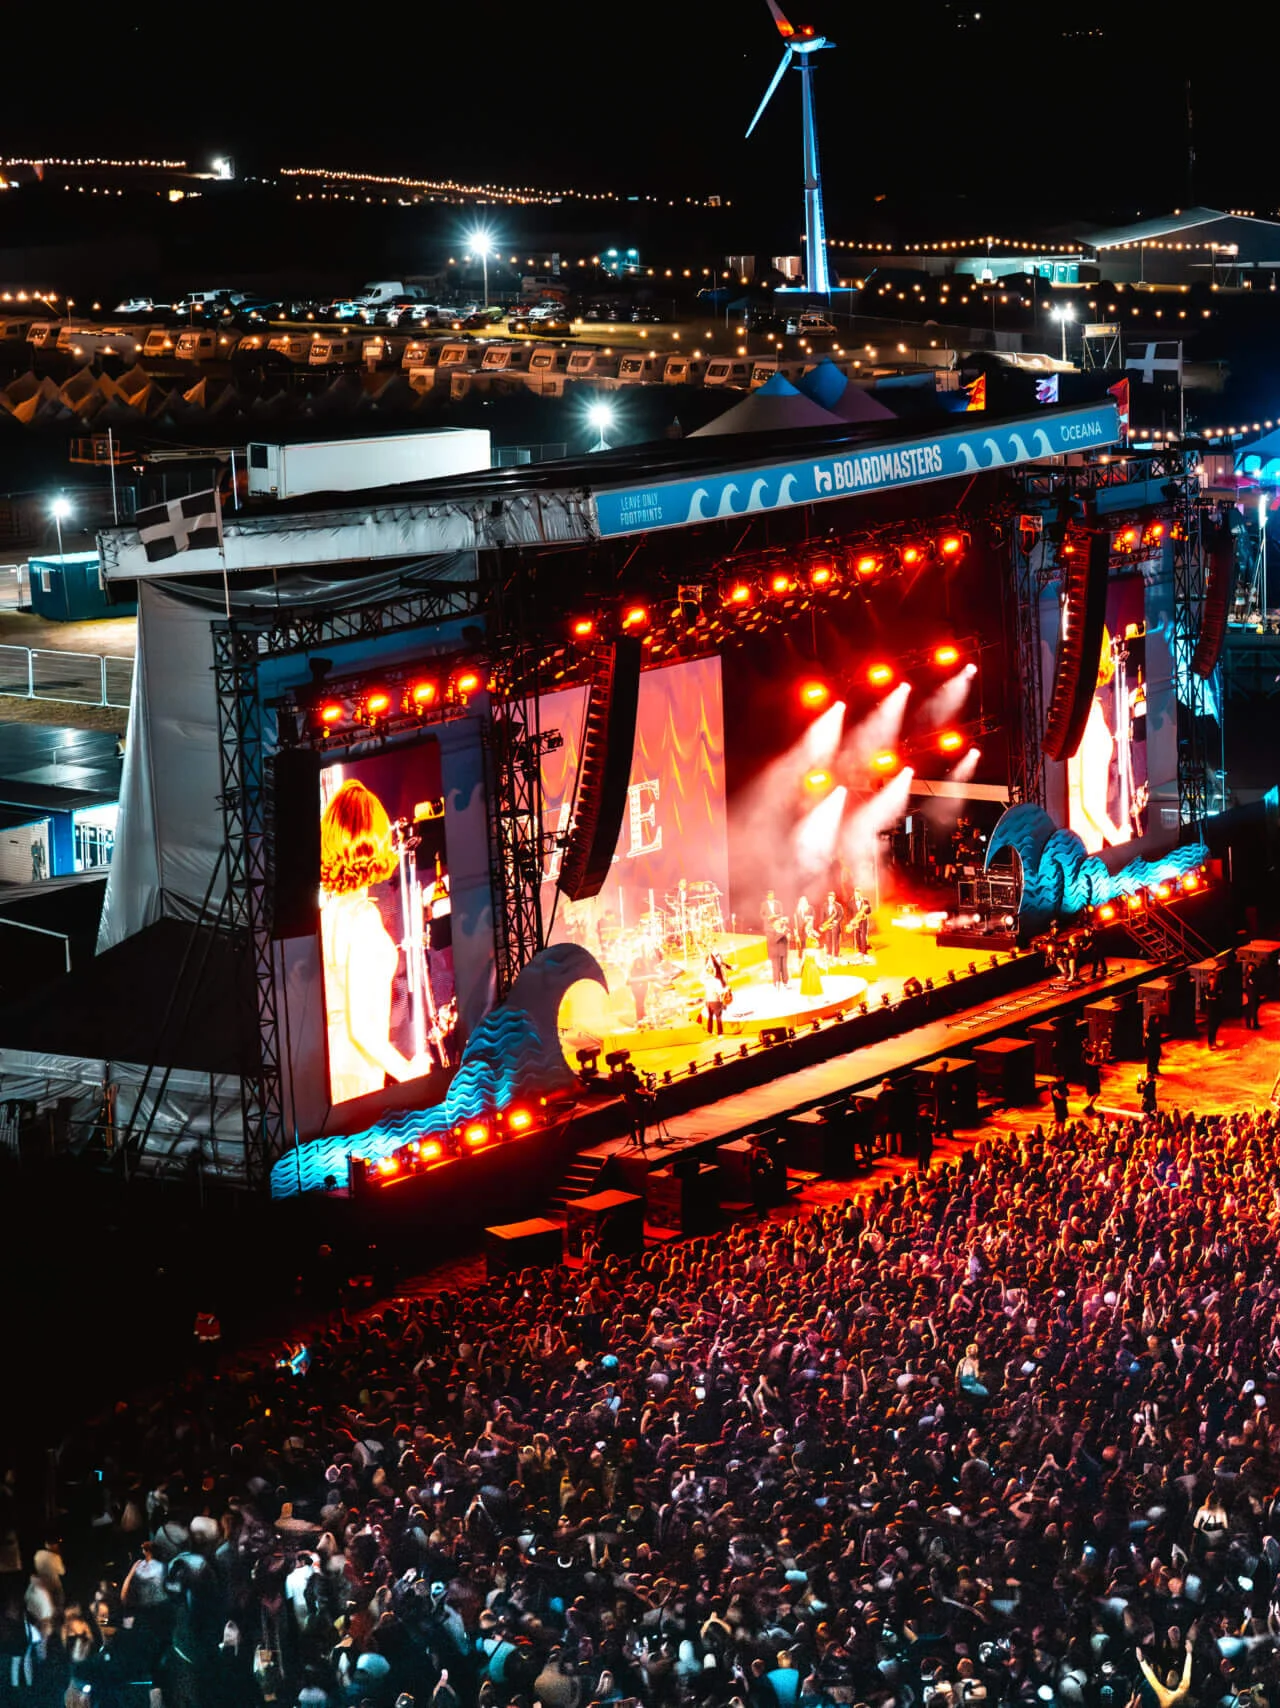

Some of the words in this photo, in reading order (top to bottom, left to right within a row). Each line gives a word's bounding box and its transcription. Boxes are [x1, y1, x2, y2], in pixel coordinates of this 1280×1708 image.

[1060, 420, 1102, 441] OCEANA
[833, 444, 943, 490] BOARDMASTERS
[620, 495, 641, 511] LEAVE
[642, 492, 658, 506] ONLY
[620, 507, 663, 526] FOOTPRINTS
